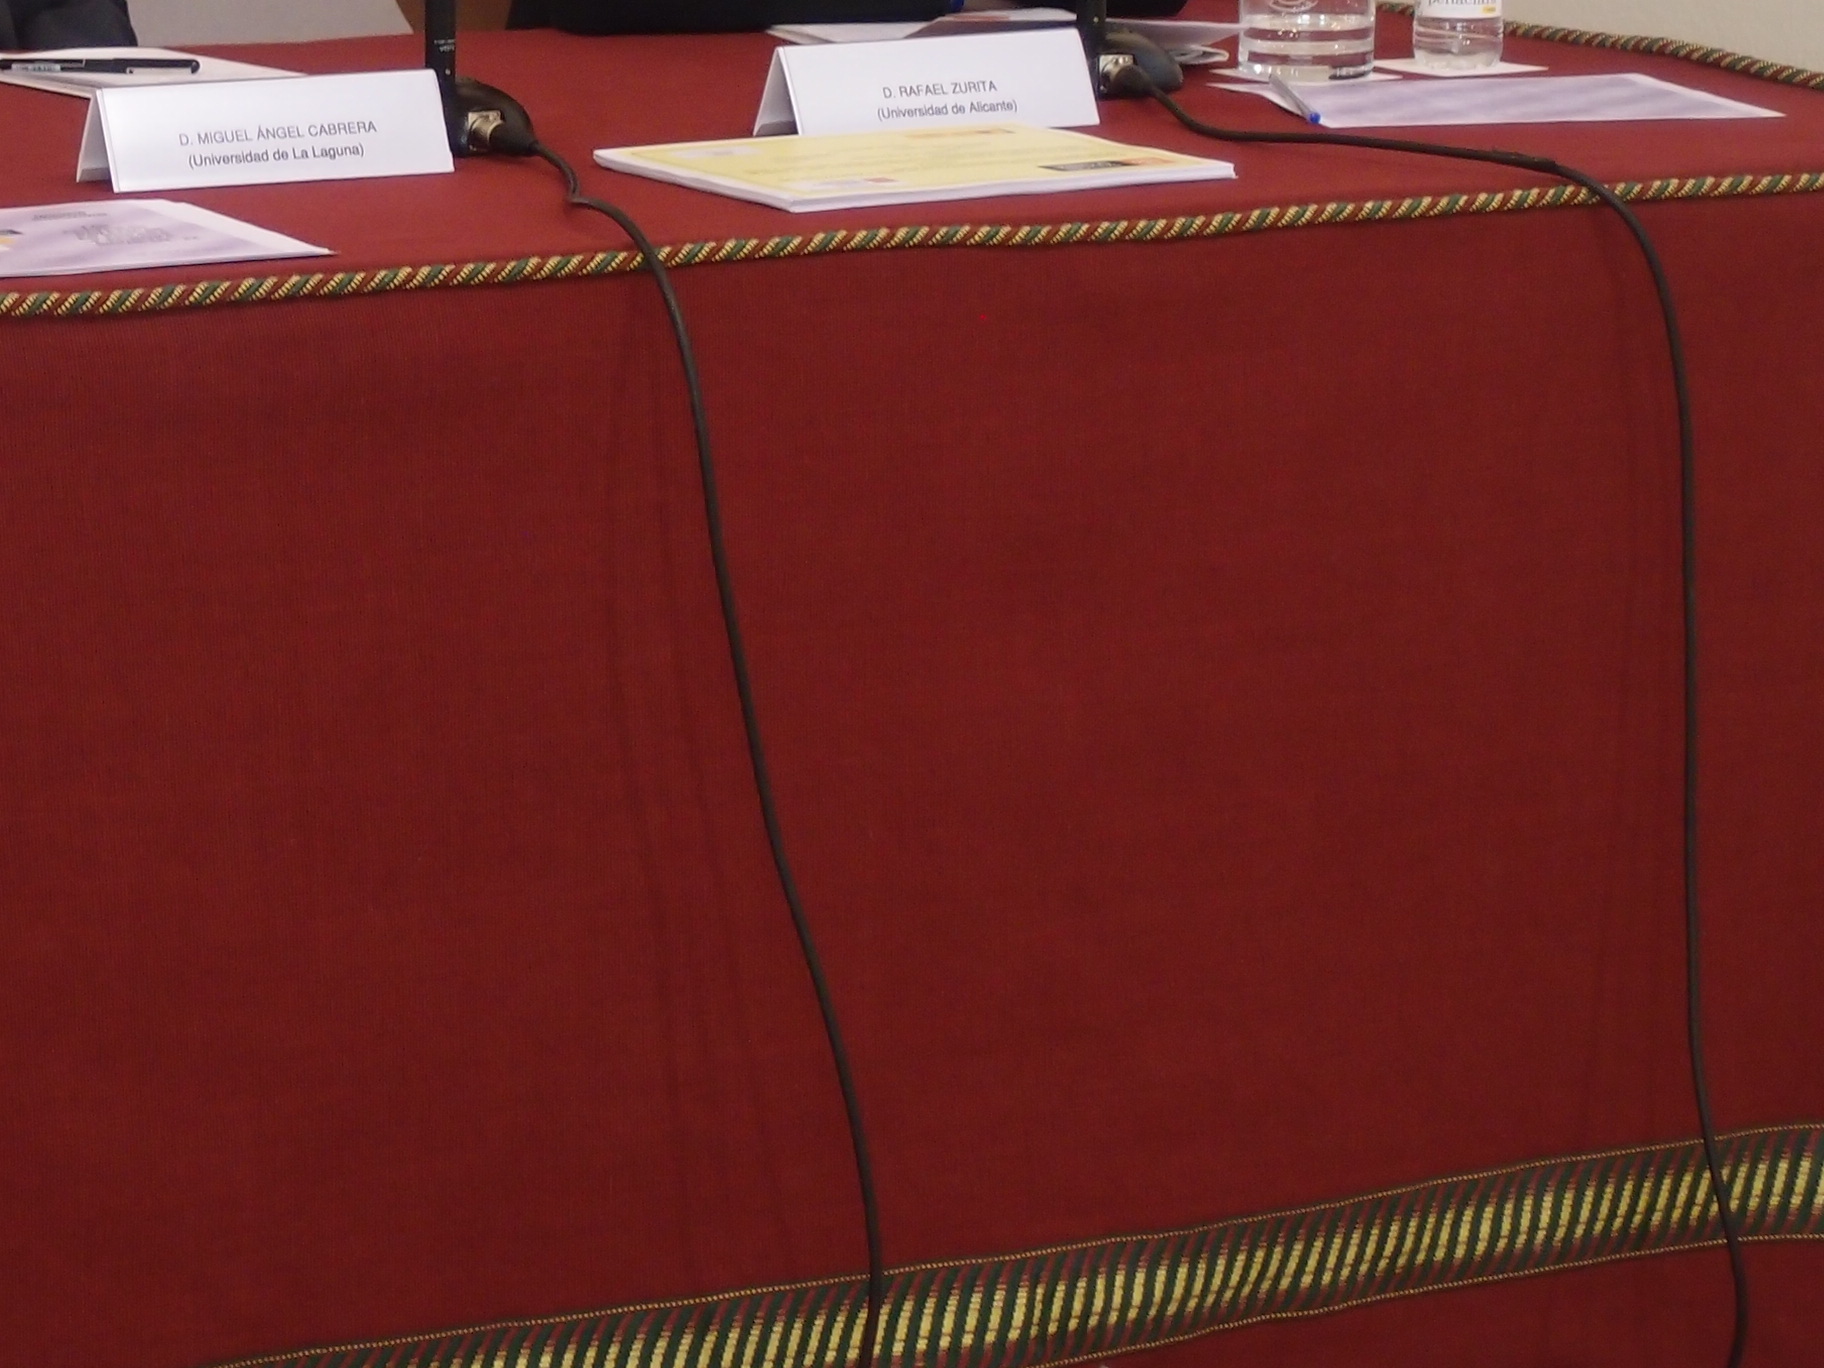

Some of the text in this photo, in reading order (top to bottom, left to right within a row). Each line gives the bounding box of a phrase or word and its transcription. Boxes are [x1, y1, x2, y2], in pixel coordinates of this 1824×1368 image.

[882, 80, 998, 99] D. RAFAEL ZURITA
[877, 99, 1018, 122] (Universidad de Alicante)
[179, 120, 378, 147] D. MIGUEL ÁNGEL CABRERA
[188, 142, 365, 170] (Universidad de La Laguna)
